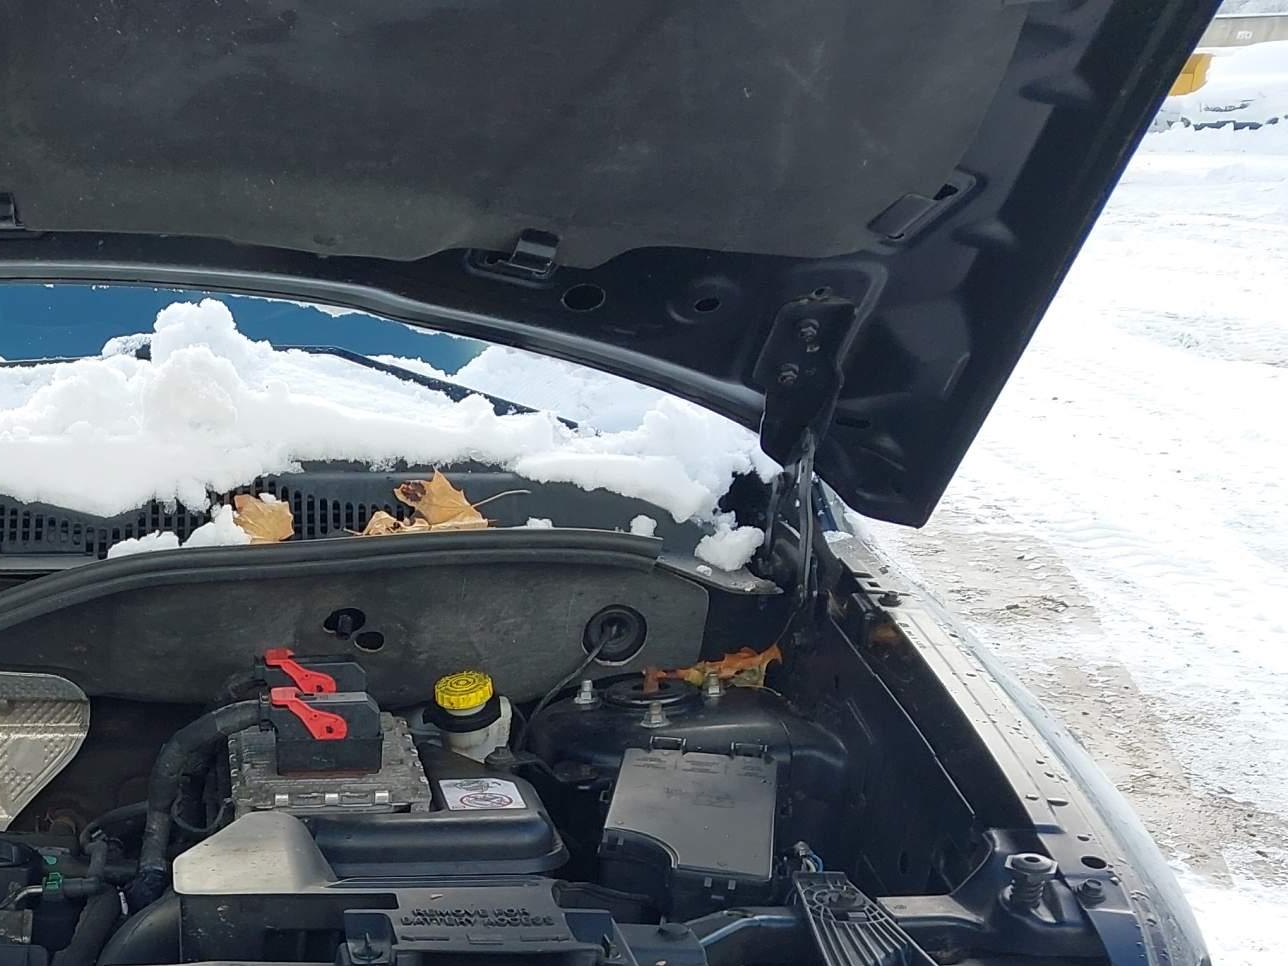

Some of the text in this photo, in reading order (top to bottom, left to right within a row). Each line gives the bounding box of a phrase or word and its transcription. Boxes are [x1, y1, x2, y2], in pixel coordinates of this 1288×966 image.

[412, 907, 530, 918] REMOVE FOR
[400, 916, 555, 927] BATTERY ACCESS
